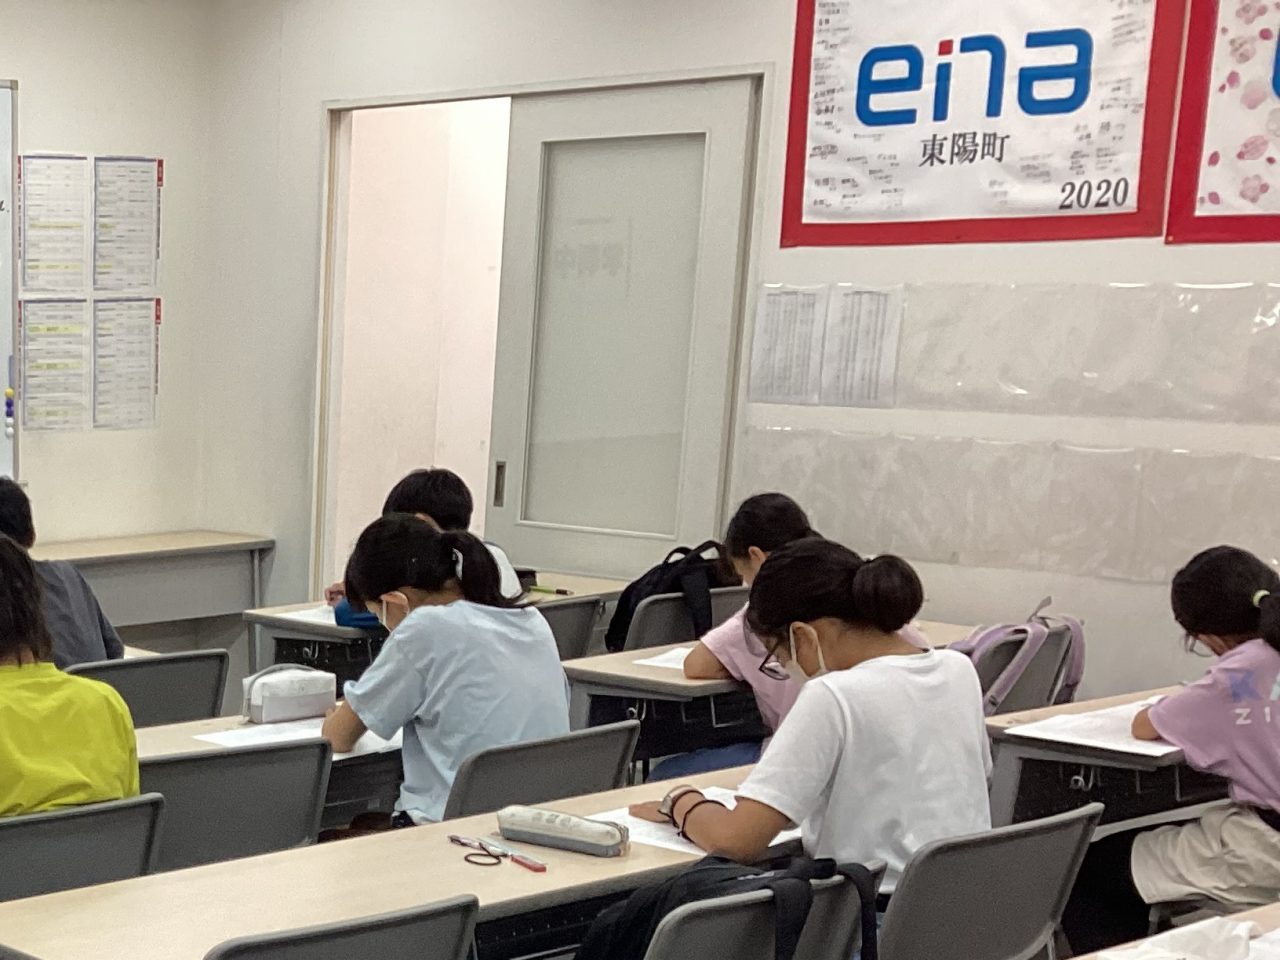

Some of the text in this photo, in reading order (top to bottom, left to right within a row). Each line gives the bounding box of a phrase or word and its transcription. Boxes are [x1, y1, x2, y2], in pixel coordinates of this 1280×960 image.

[855, 27, 1093, 127] ena
[918, 132, 1011, 167] 東陽町
[1059, 177, 1129, 210] 2020
